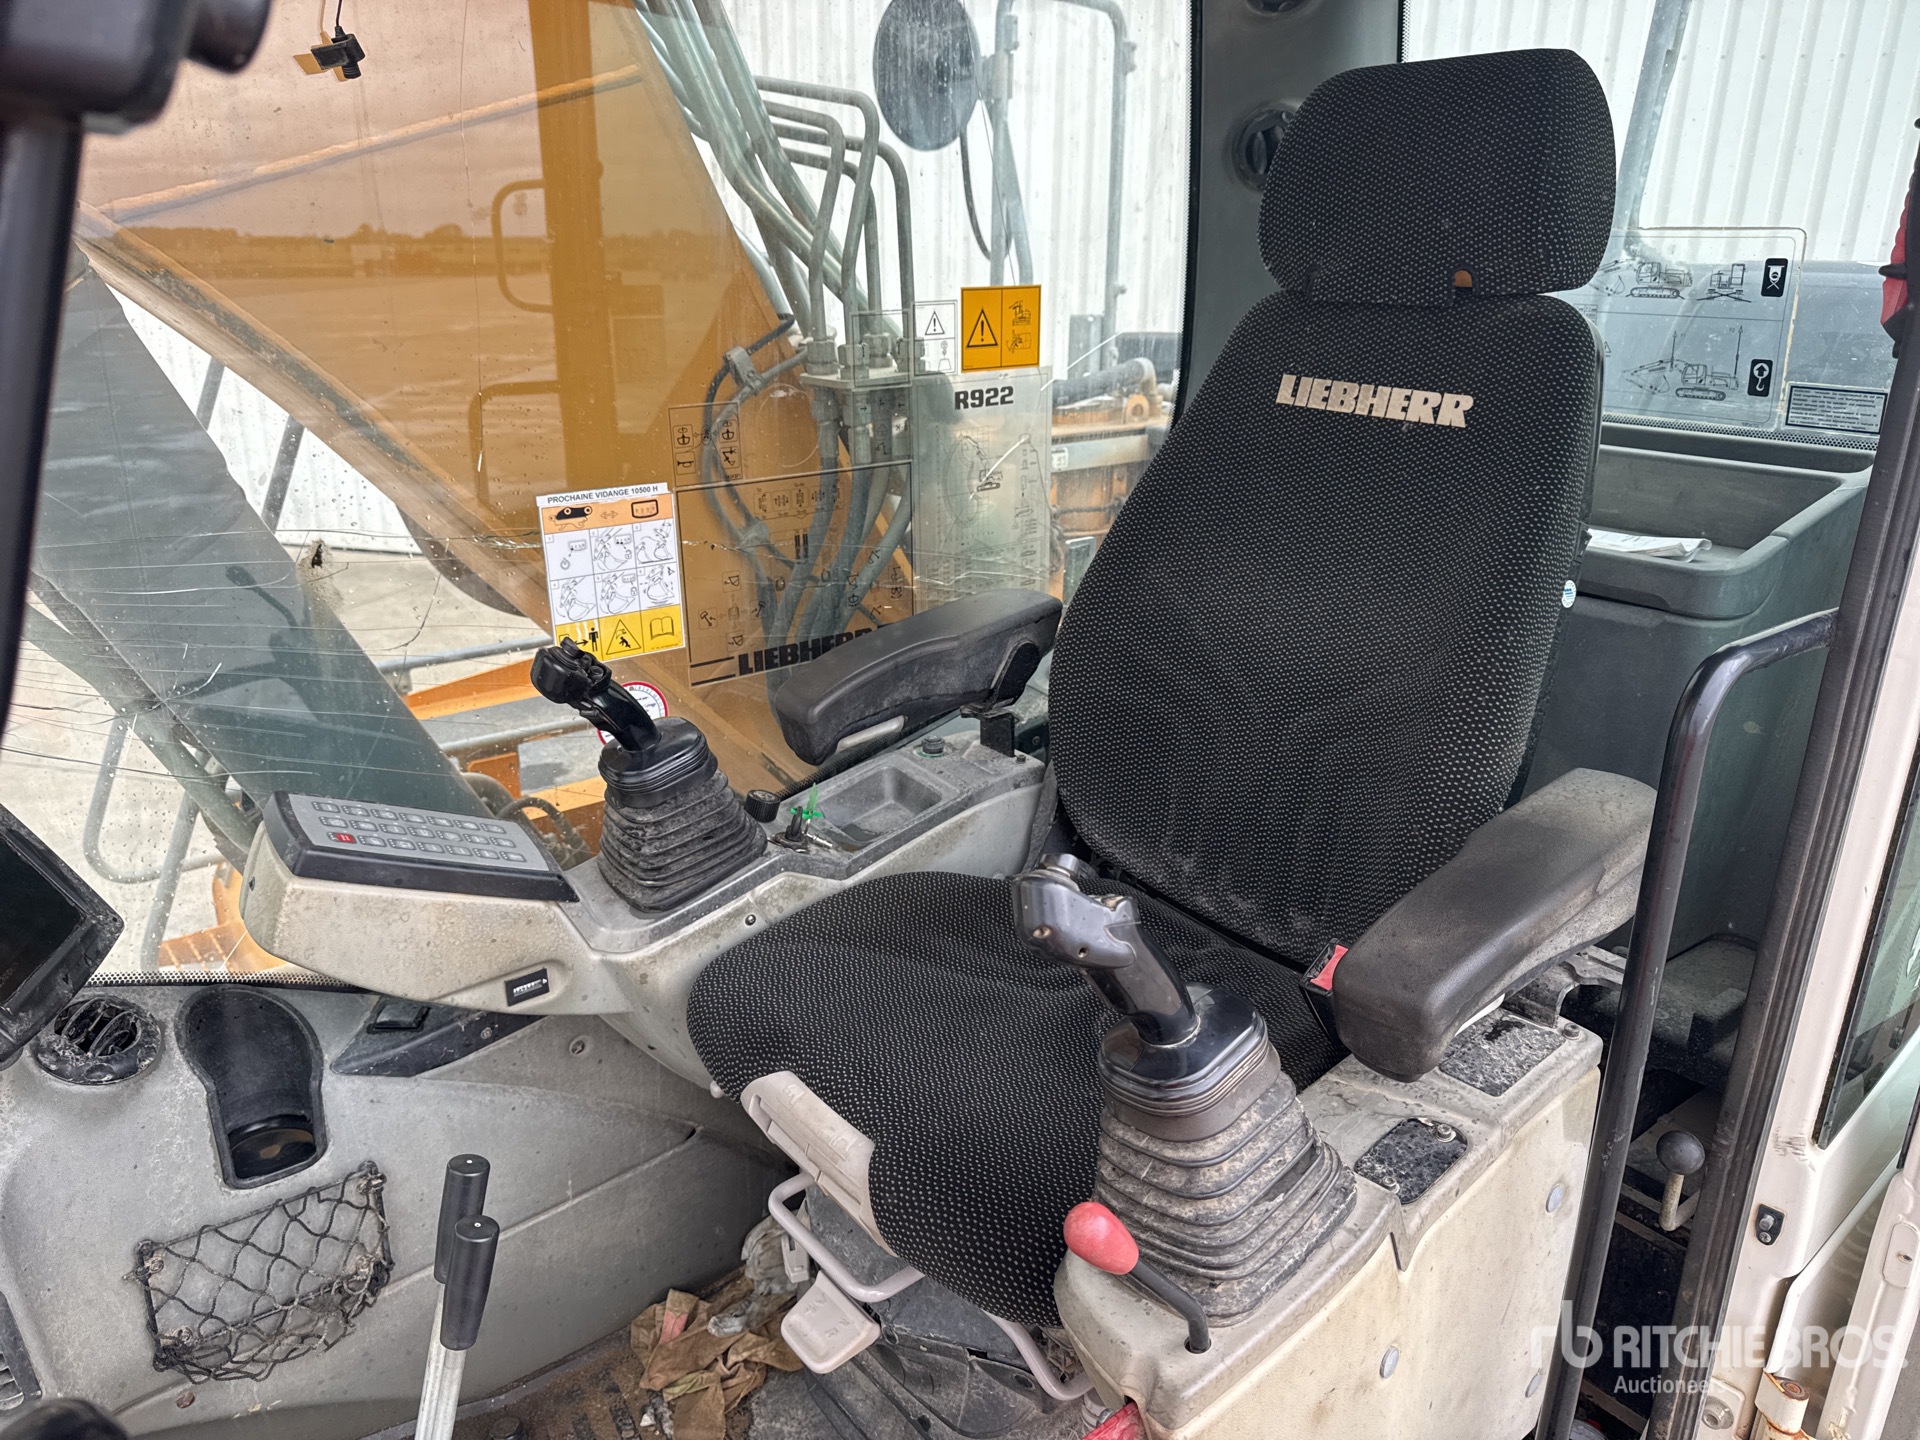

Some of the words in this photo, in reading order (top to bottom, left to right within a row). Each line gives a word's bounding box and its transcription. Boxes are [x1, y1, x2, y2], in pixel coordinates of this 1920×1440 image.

[954, 386, 1014, 410] R922
[1276, 374, 1474, 428] LIEBHERR
[547, 493, 594, 503] PROCHAINE
[595, 489, 629, 498] VIDANGE
[631, 486, 651, 494] 10500
